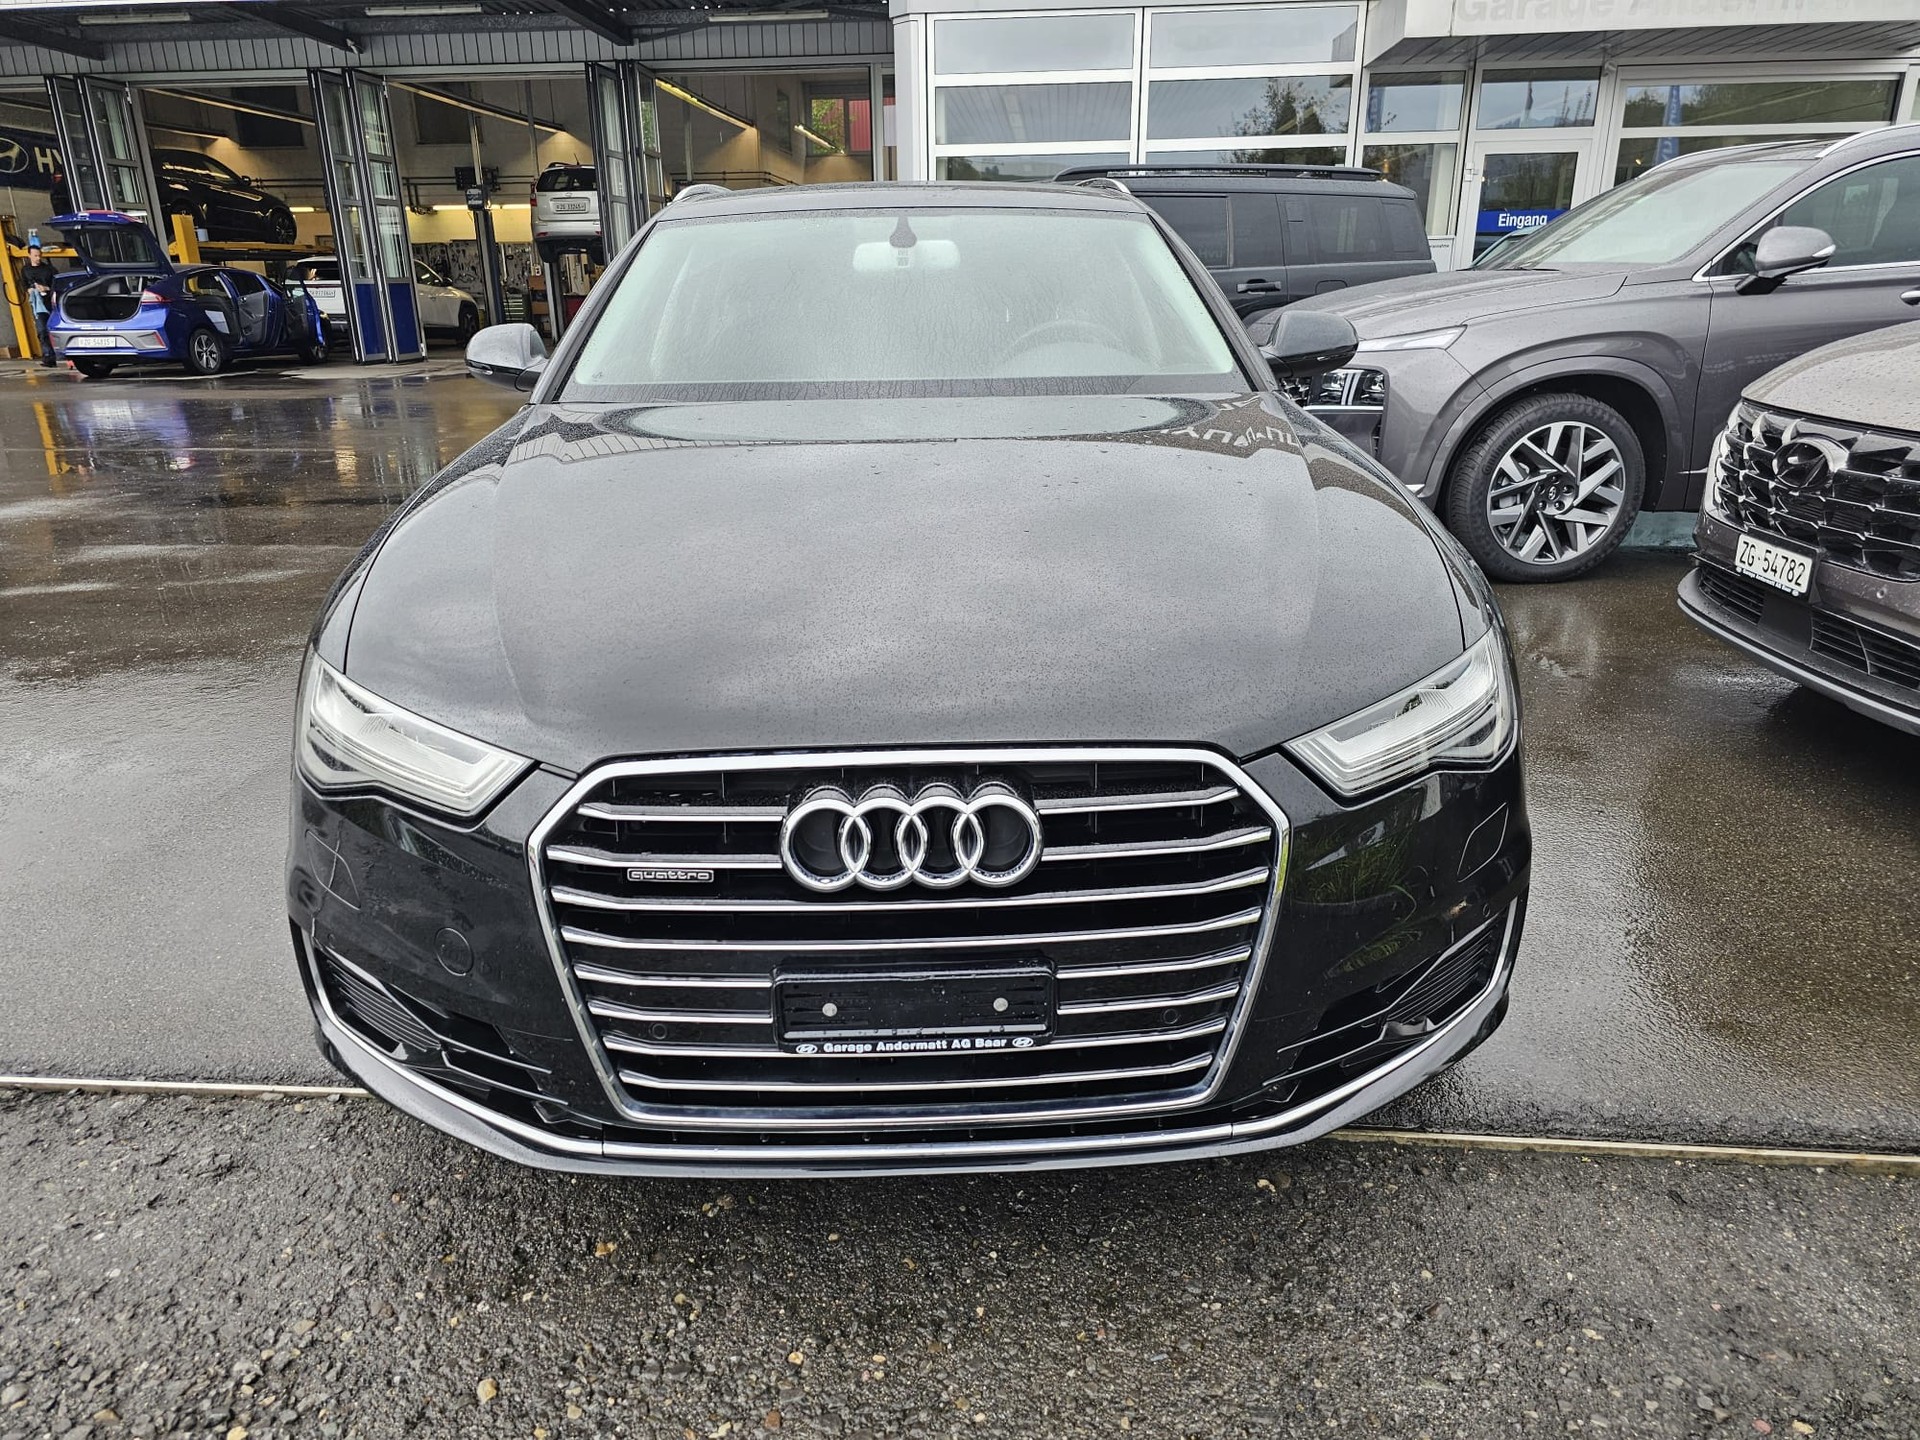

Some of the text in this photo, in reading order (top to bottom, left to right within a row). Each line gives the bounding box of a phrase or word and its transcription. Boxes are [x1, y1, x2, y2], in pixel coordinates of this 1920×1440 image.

[1498, 213, 1548, 228] Eingang
[631, 870, 710, 881] quattro
[823, 1038, 1007, 1054] Garage Andermatt AG Baar
